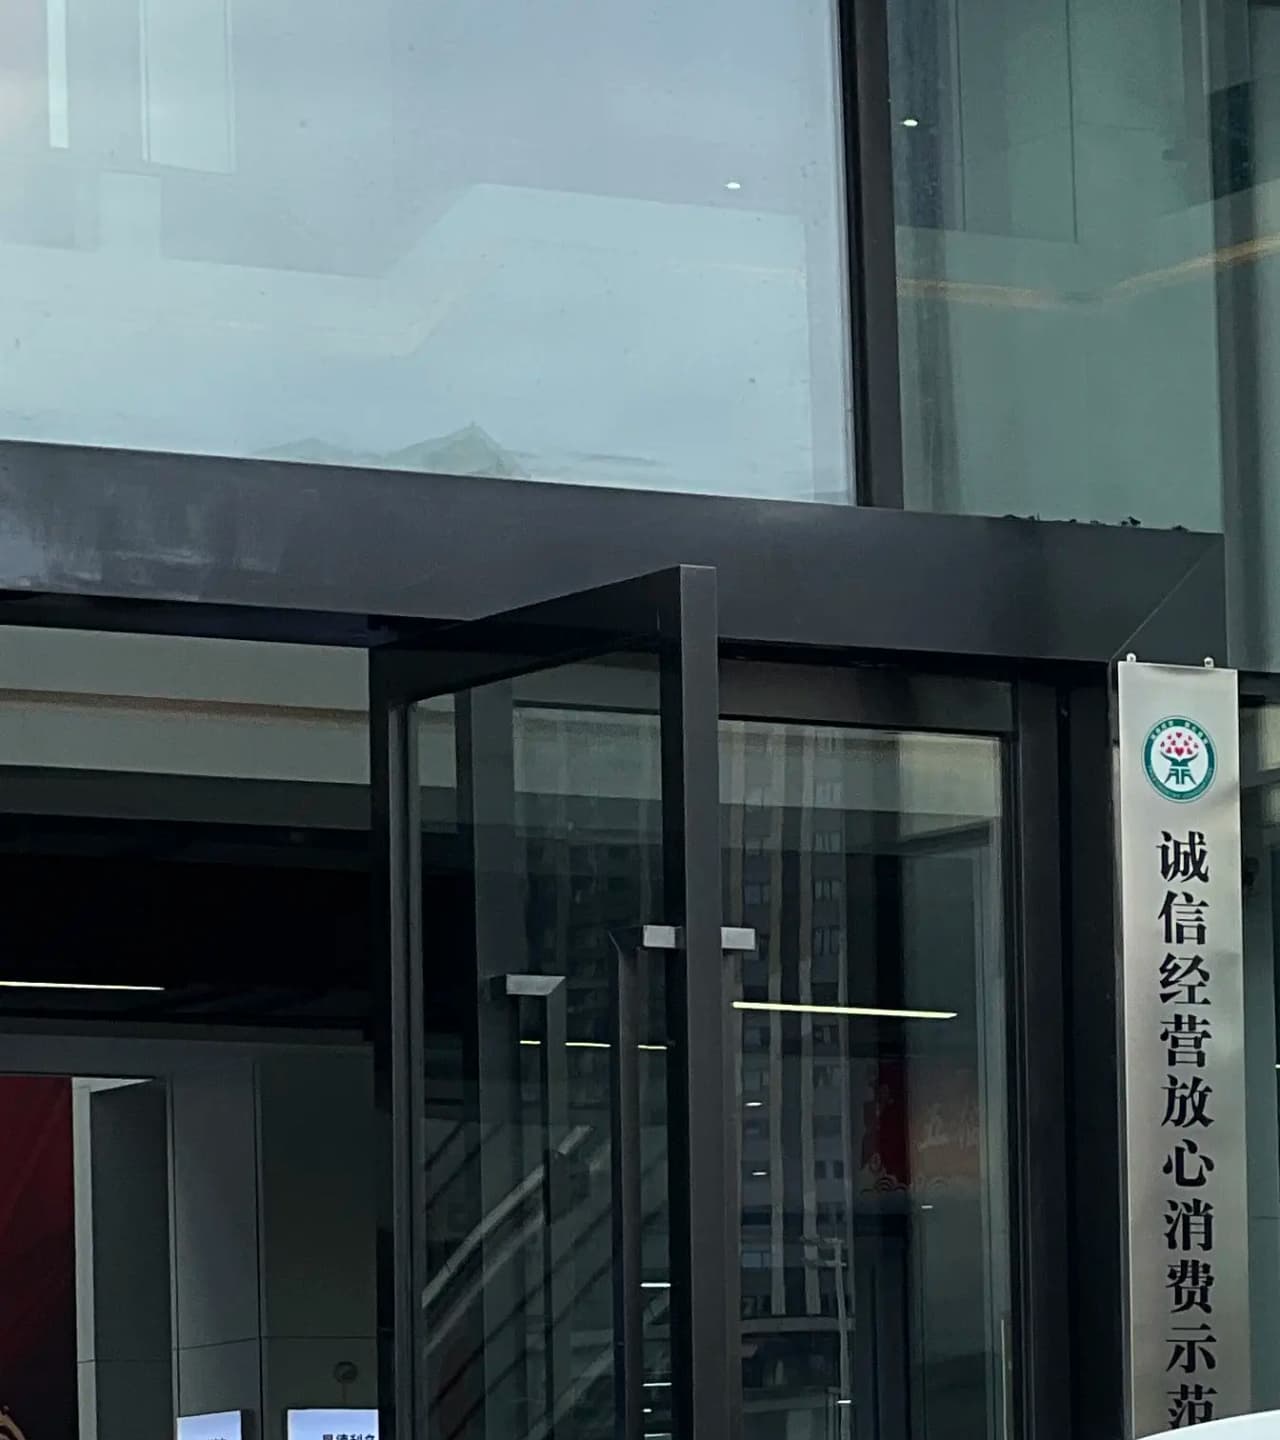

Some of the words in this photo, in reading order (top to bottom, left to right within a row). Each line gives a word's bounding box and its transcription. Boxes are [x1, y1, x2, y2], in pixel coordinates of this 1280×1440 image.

[1155, 830, 1217, 1430] 诚信经营放心消费示范
